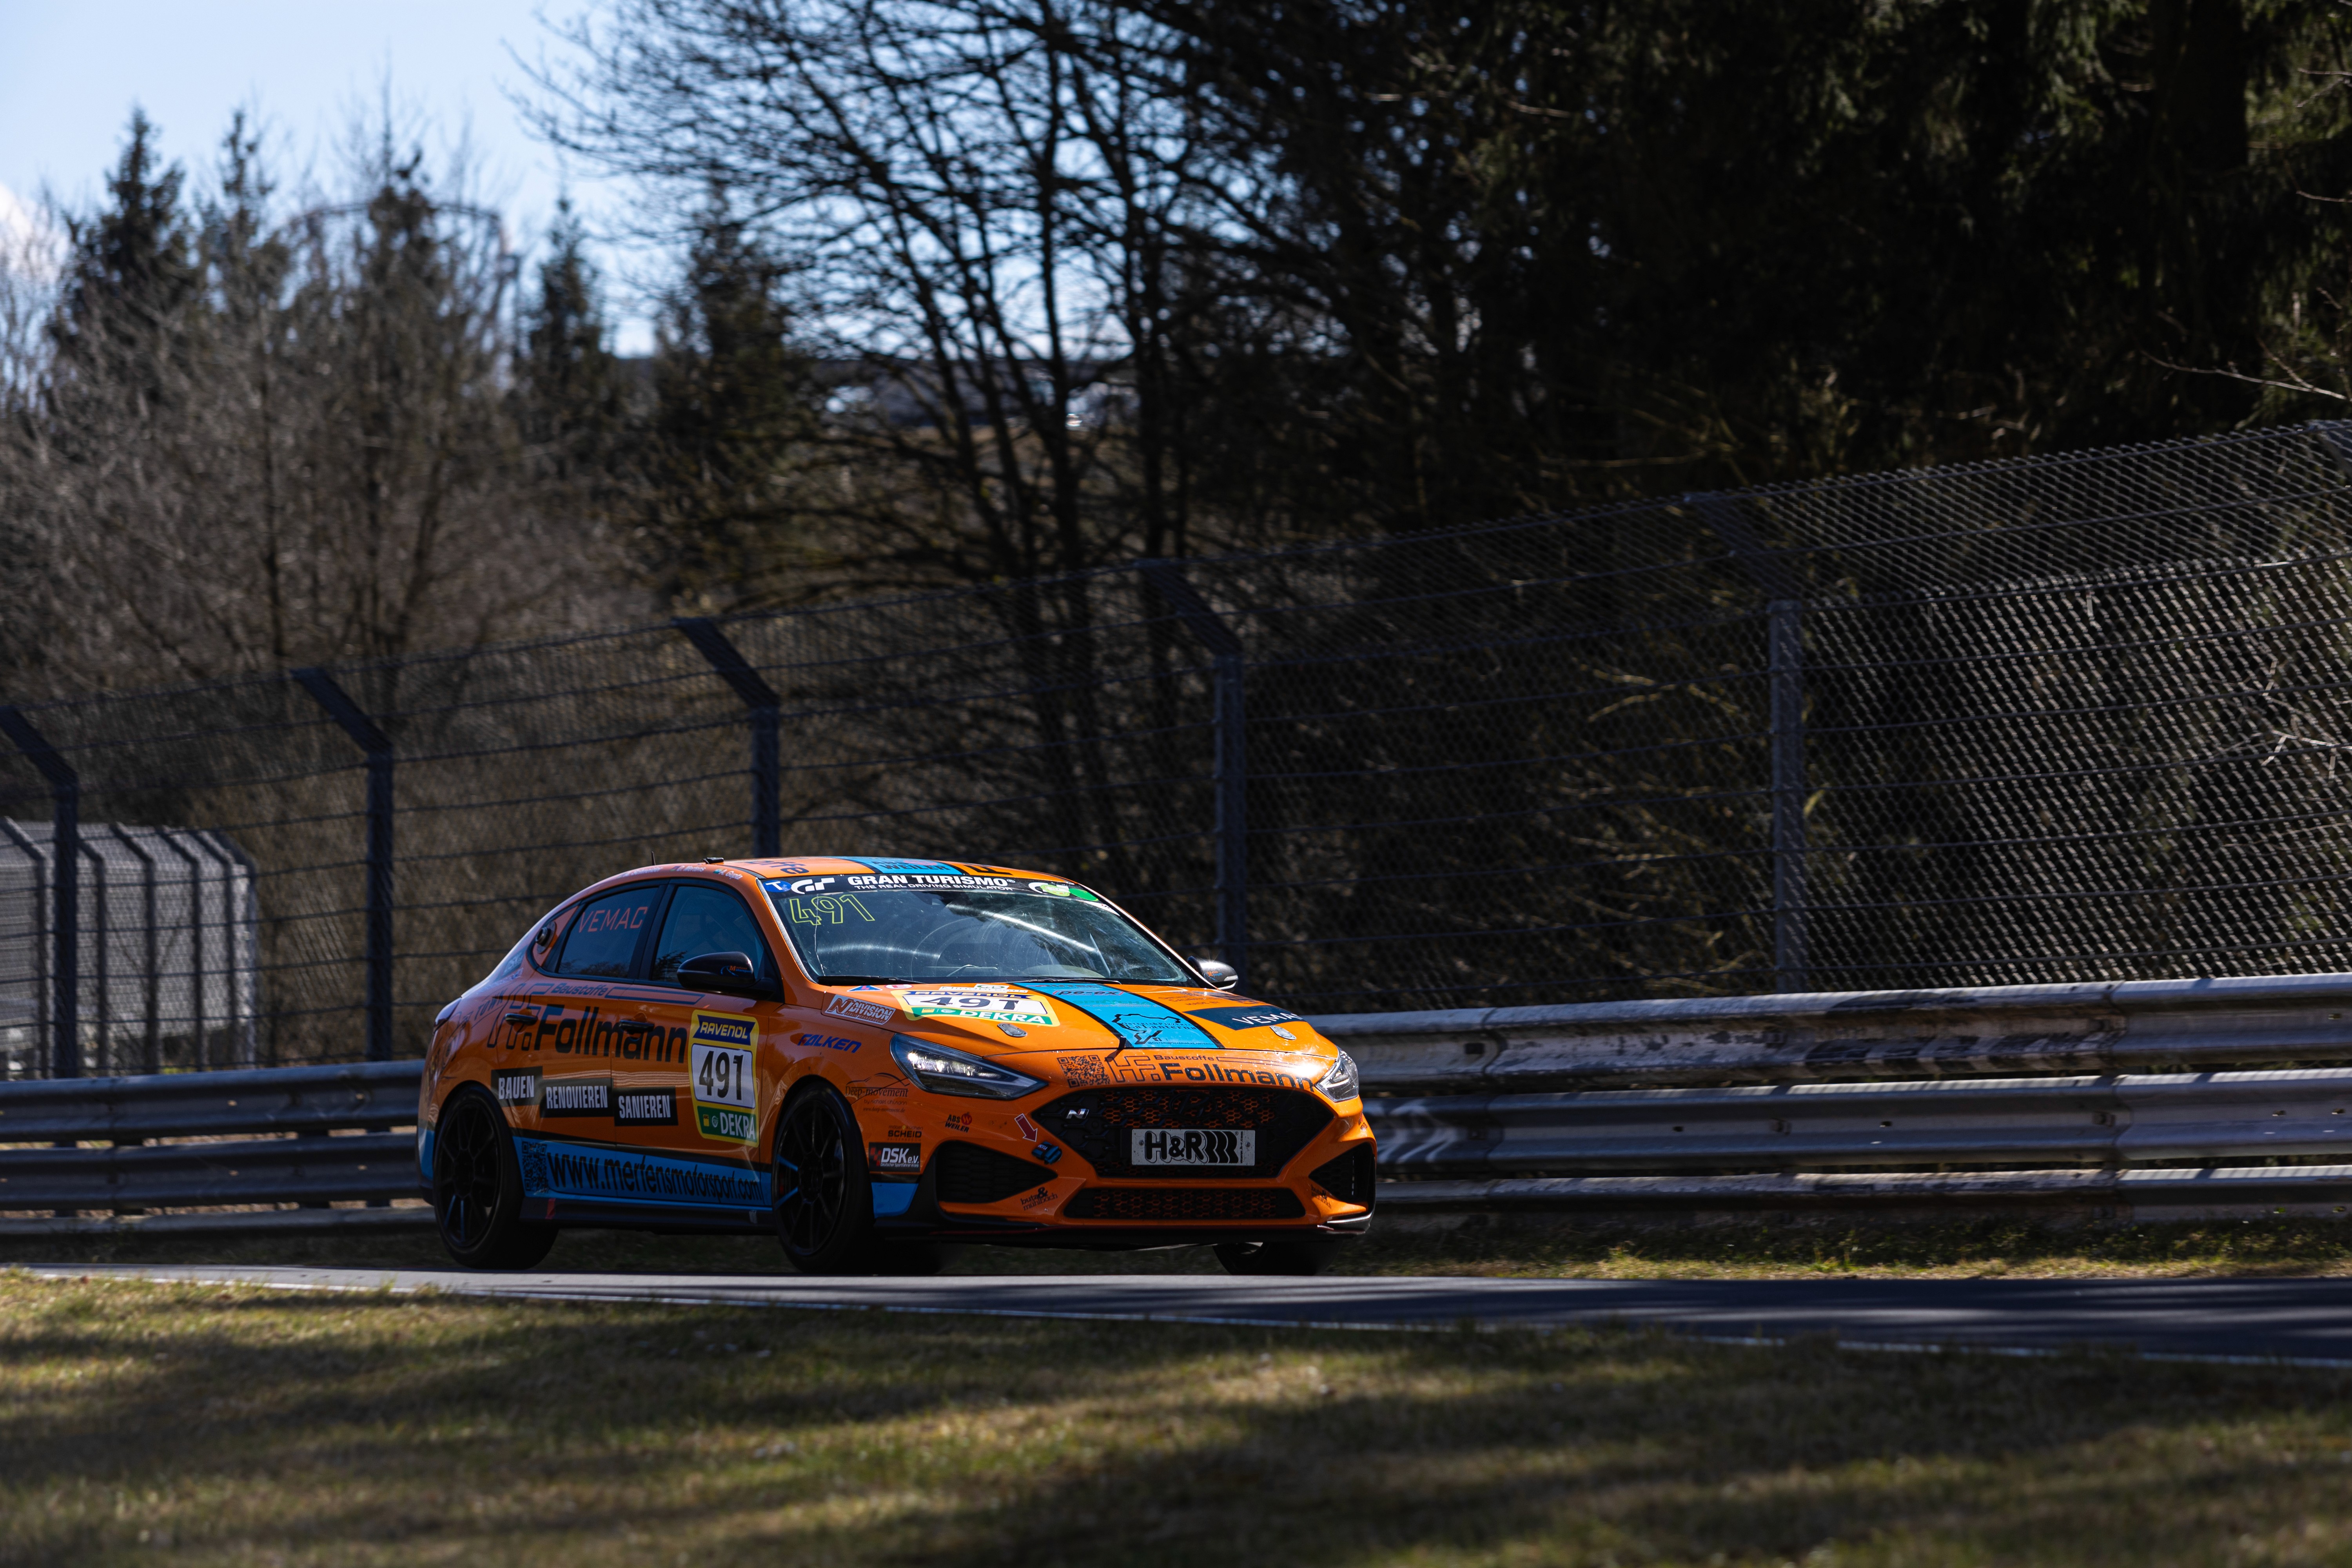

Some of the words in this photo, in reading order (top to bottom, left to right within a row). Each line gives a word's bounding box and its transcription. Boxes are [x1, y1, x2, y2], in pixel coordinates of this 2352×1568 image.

[848, 875, 908, 886] GRAN
[579, 906, 648, 933] VEMAC
[789, 894, 875, 926] 491
[552, 983, 608, 996] Baustoffe
[851, 1001, 894, 1020] DIVISION
[919, 997, 1019, 1010] 491
[960, 1009, 1045, 1024] DEKRA
[534, 1004, 688, 1063] Follmann
[700, 1022, 748, 1039] RAVENOL
[797, 1034, 862, 1053] FALKEN
[699, 1051, 744, 1100] 491
[1159, 1063, 1314, 1093] Follmann
[498, 1075, 535, 1100] BAUEN
[546, 1085, 608, 1109] RENOVIEREN
[619, 1095, 671, 1119] SANIEREN
[845, 1086, 909, 1098] Deep-movement
[720, 1112, 755, 1140] DEKRA
[945, 1121, 969, 1132] WEILER
[947, 1114, 960, 1123] ABS
[880, 1147, 909, 1163] DSK
[907, 1155, 919, 1163] e.V.
[547, 1152, 762, 1203] www.mertensmotorsport.com
